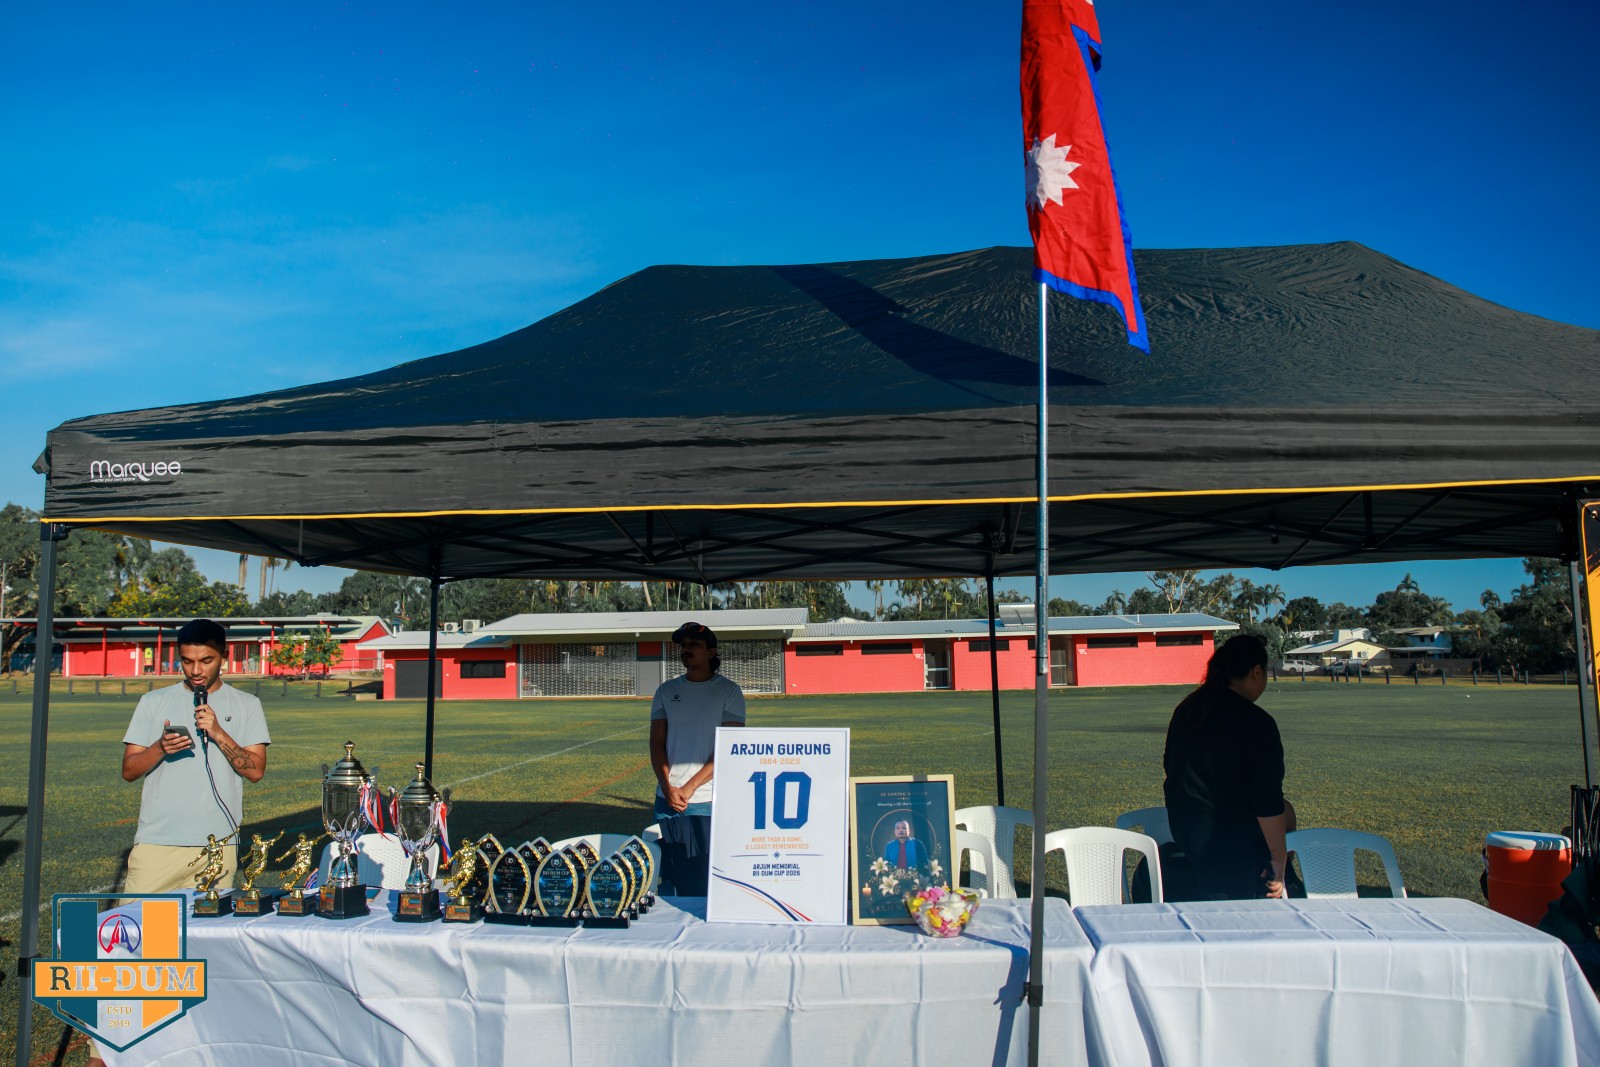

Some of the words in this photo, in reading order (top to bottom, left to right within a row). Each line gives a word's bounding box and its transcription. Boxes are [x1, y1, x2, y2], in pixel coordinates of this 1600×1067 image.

[731, 743, 774, 755] ARJUN
[777, 743, 831, 755] GURUNG
[760, 757, 801, 765] 1984-2025
[747, 771, 812, 830] 10
